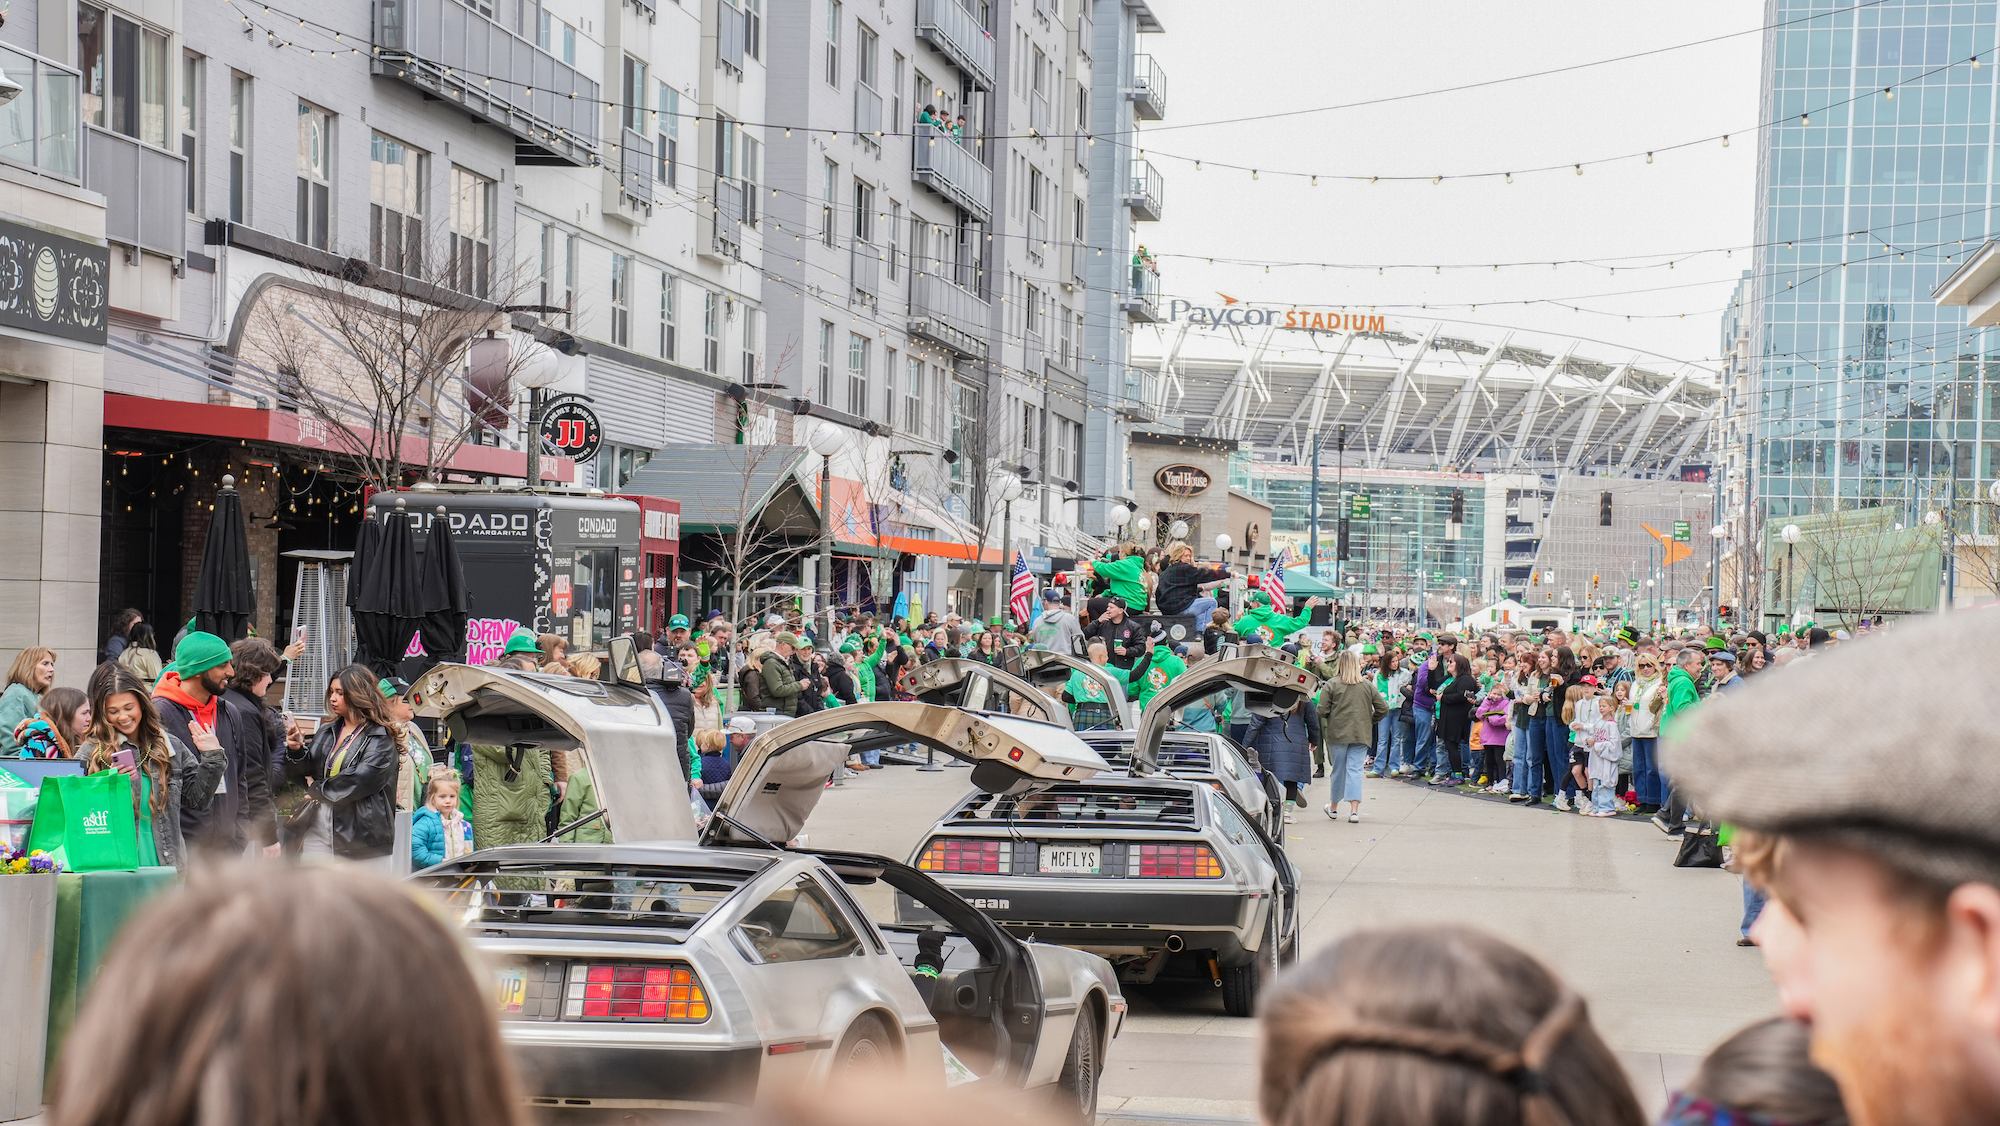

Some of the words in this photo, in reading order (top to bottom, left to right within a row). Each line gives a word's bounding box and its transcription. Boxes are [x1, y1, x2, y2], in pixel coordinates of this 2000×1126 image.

[1170, 299, 1281, 331] Paycor
[1286, 311, 1385, 332] STADIUM
[545, 406, 570, 429] JIMMY
[572, 406, 597, 430] JOHN'S
[297, 417, 327, 446] STRETCH
[556, 419, 586, 449] JJ
[1165, 471, 1183, 486] Yard
[1184, 472, 1207, 488] House
[579, 517, 617, 533] CONDADO
[83, 810, 108, 827] asdf
[1051, 851, 1095, 868] MCFLYS
